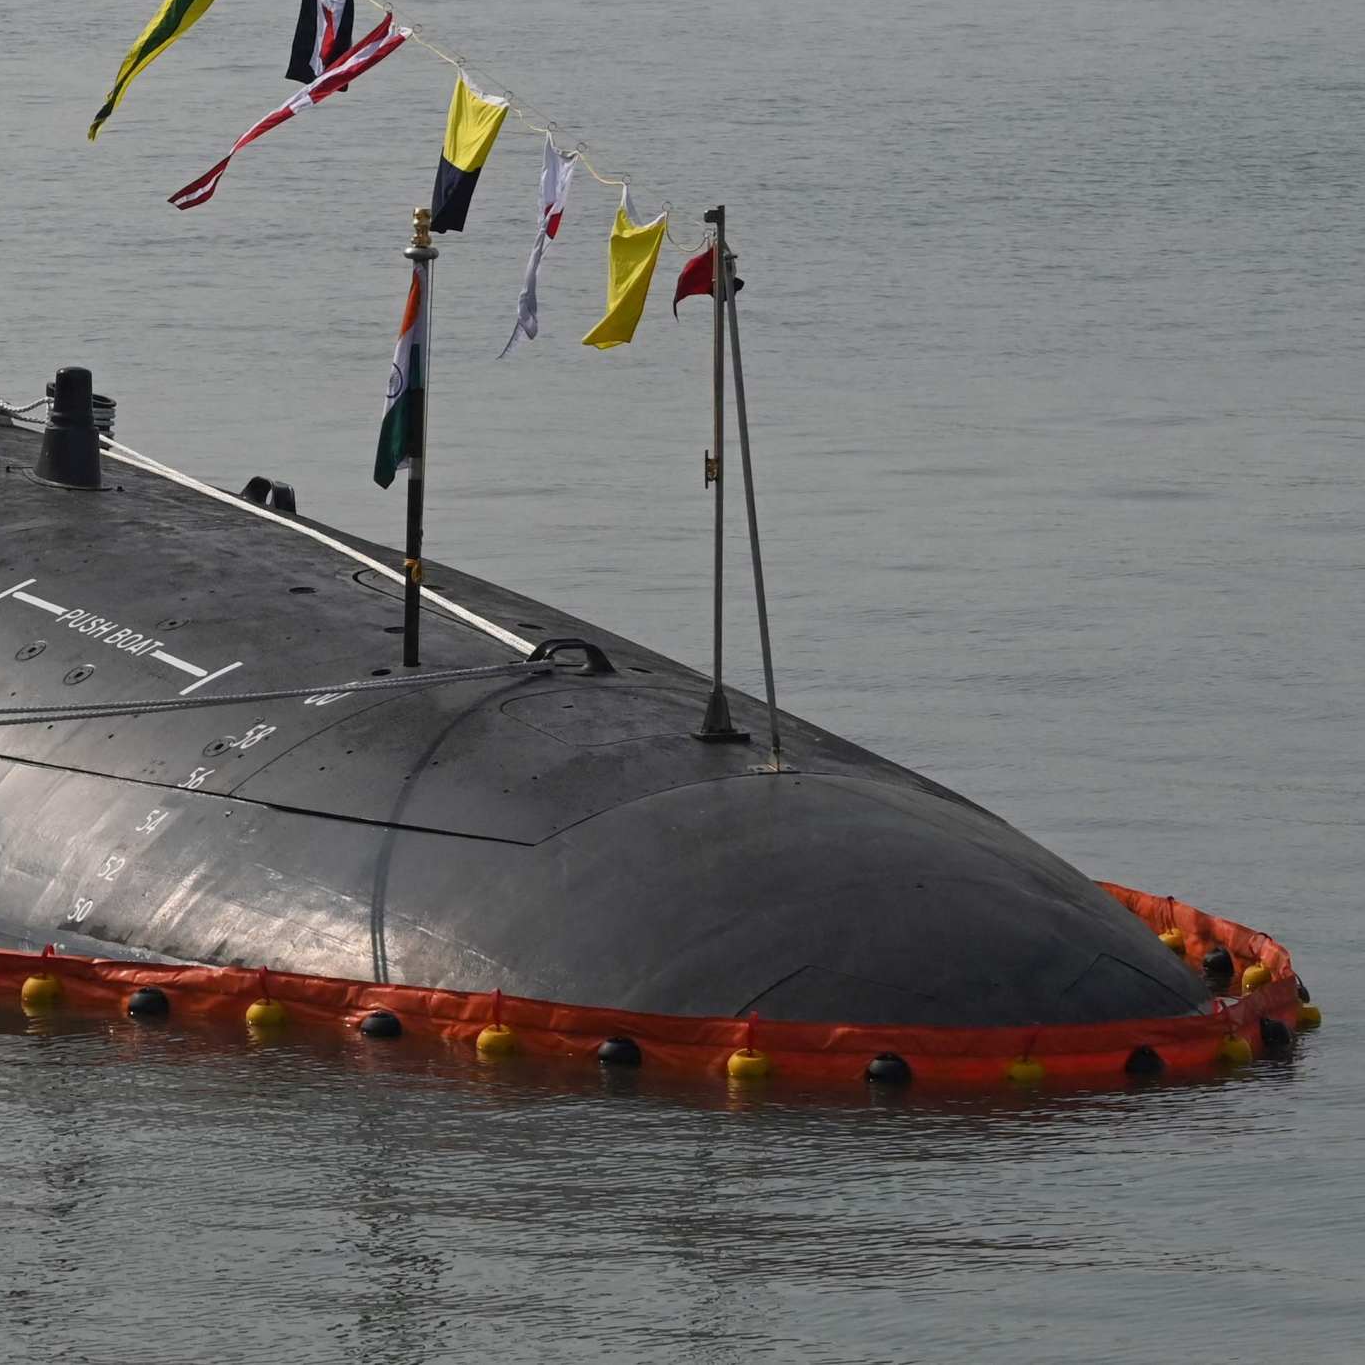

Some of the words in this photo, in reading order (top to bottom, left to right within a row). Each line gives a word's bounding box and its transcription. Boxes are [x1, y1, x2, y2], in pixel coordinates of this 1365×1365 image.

[54, 608, 119, 639] PUSH
[102, 628, 165, 656] BOAT
[229, 724, 277, 750] 58
[177, 766, 216, 789] 56
[134, 809, 169, 835] 54
[96, 855, 126, 881] 52
[67, 897, 93, 923] 50
